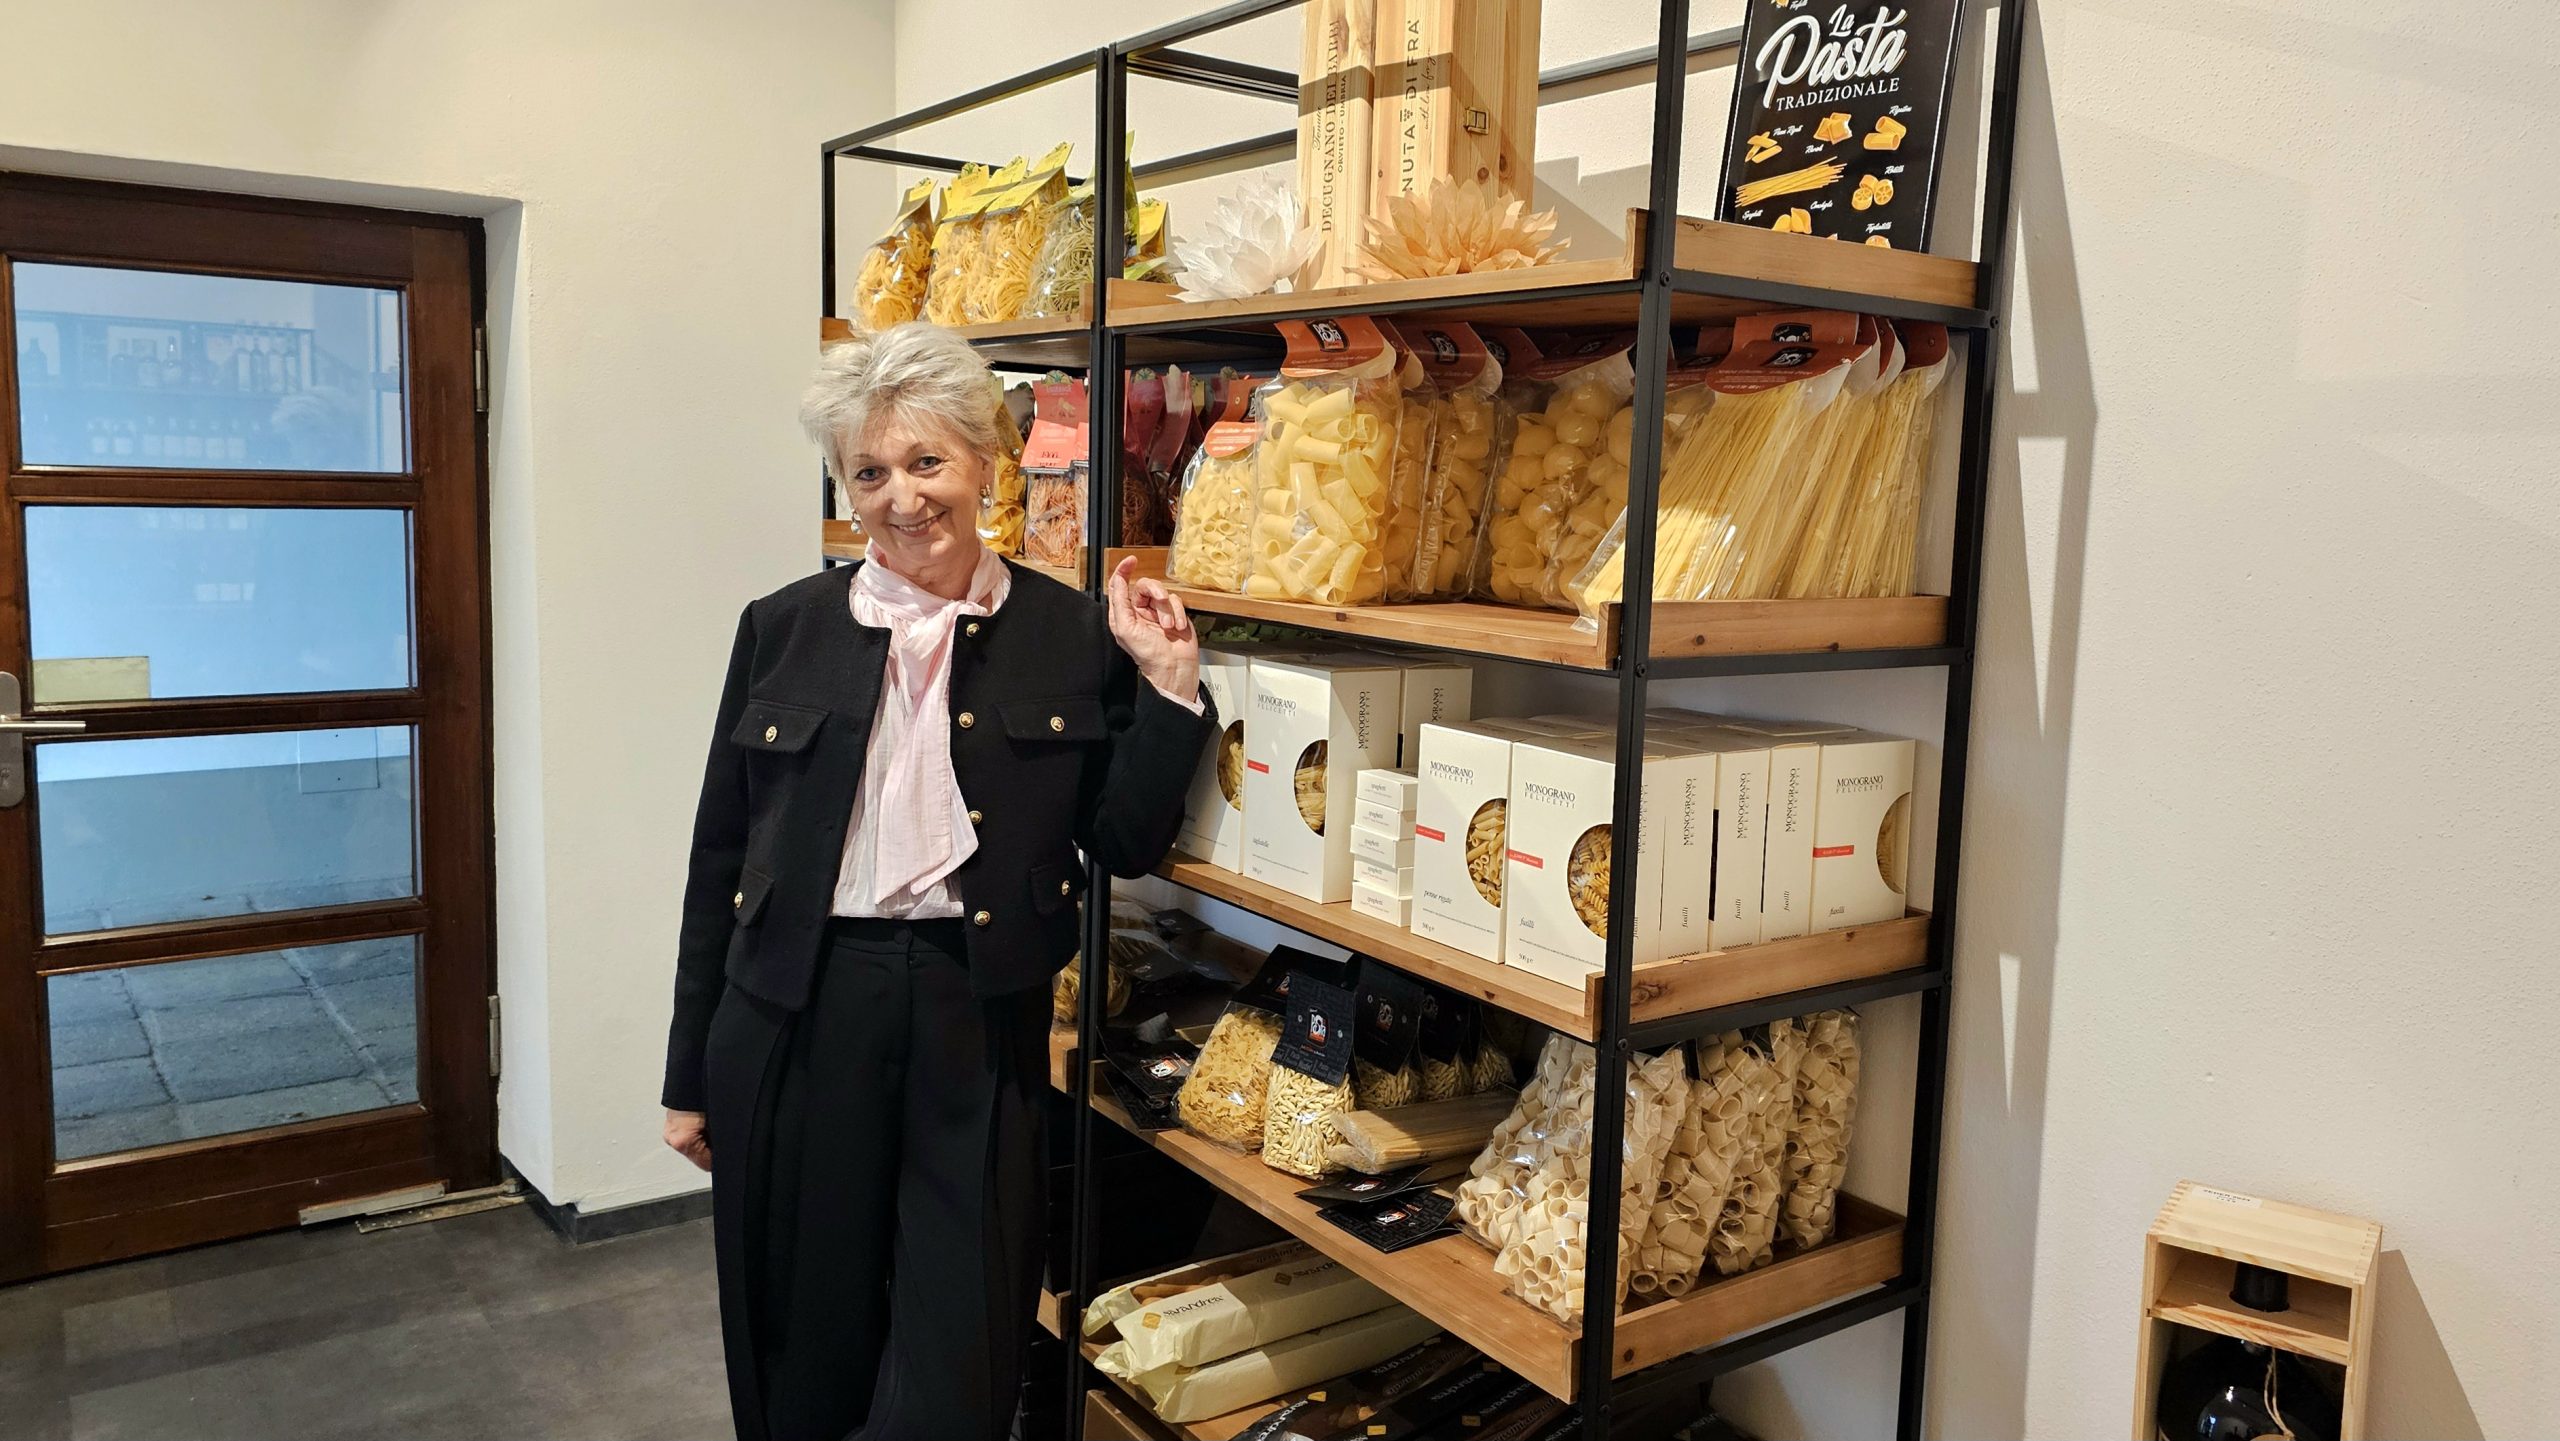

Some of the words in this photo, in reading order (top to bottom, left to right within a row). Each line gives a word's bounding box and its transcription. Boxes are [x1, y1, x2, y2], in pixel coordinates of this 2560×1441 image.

[1828, 3, 1855, 38] La
[1327, 20, 1340, 76] BARBI
[1755, 5, 1908, 109] Pasta
[1326, 78, 1337, 116] DEI
[1339, 74, 1347, 117] UMBRIA
[1406, 77, 1418, 100] DI
[1776, 77, 1900, 112] TRADIZIONALE
[1312, 105, 1322, 151] Tenuta
[1337, 126, 1345, 174] ORVIETO
[1402, 124, 1416, 192] NUTA
[1321, 121, 1336, 233] DECUGNANO
[1258, 693, 1297, 711] MONOGRANO
[1358, 691, 1366, 749] MONOGRANO
[1429, 770, 1474, 785] FELICETTI
[1430, 760, 1474, 779] MONOGRANO
[1836, 784, 1883, 793] FELICETTI
[1837, 775, 1884, 787] MONOGRANO
[1524, 791, 1575, 809] FELICETTI
[1525, 782, 1576, 802] MONOGRANO
[1683, 778, 1692, 846] MONOGRANO
[1737, 773, 1747, 839] MONOGRANO
[1785, 768, 1796, 832] MONOGRANO
